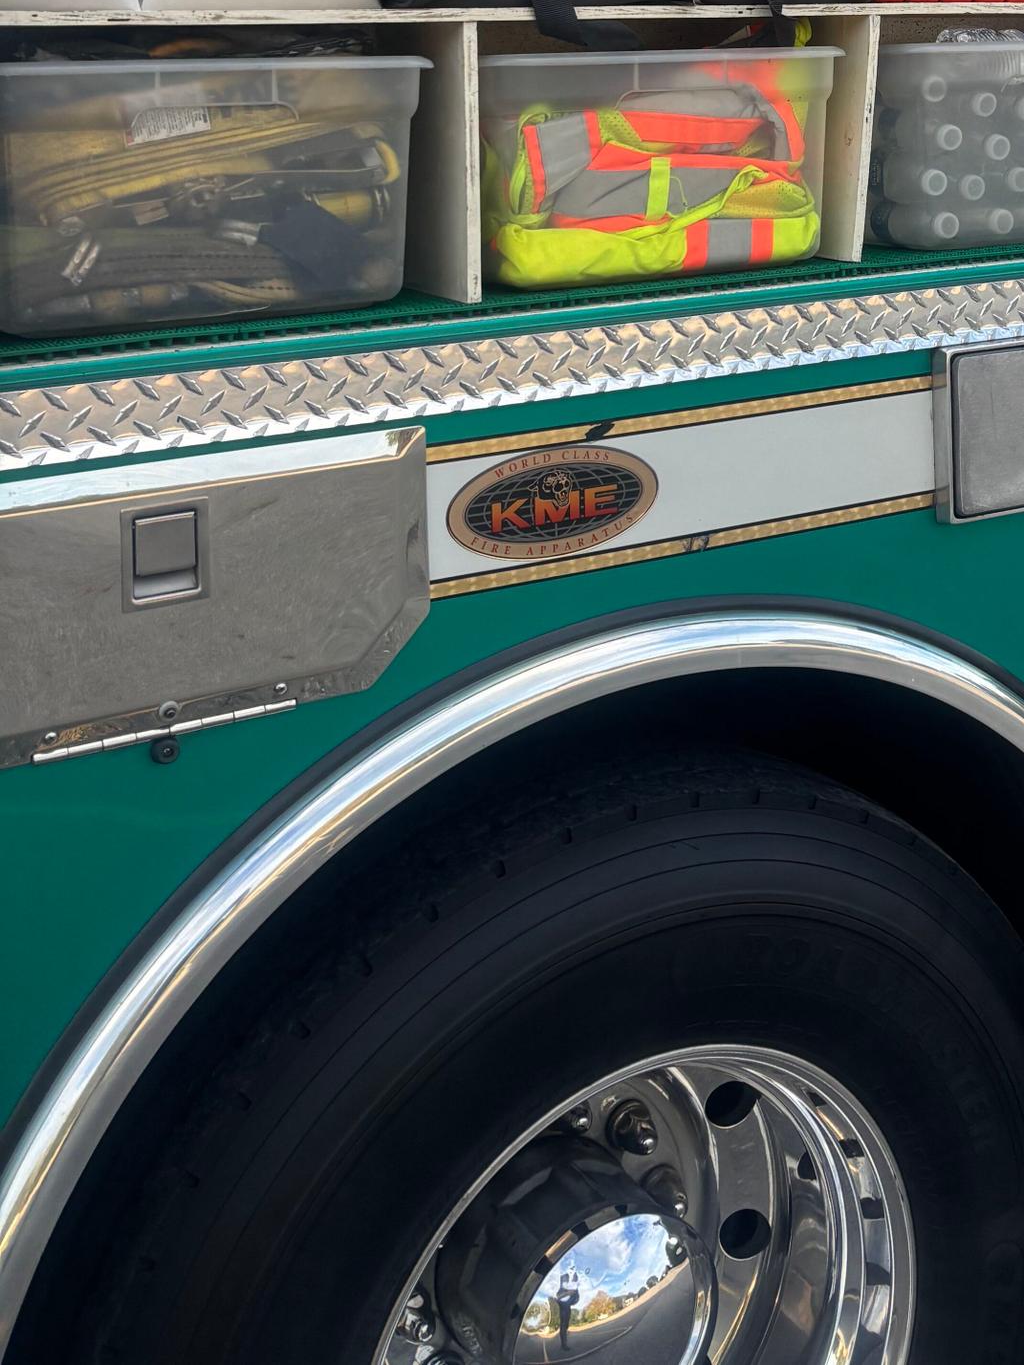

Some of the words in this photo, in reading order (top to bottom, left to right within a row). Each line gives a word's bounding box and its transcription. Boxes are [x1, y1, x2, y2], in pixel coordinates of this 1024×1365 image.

[494, 452, 552, 480] WORLD
[561, 450, 610, 462] CLASS
[490, 483, 620, 534] KME
[470, 537, 511, 555] FIRE
[526, 514, 635, 556] APPARATUS
